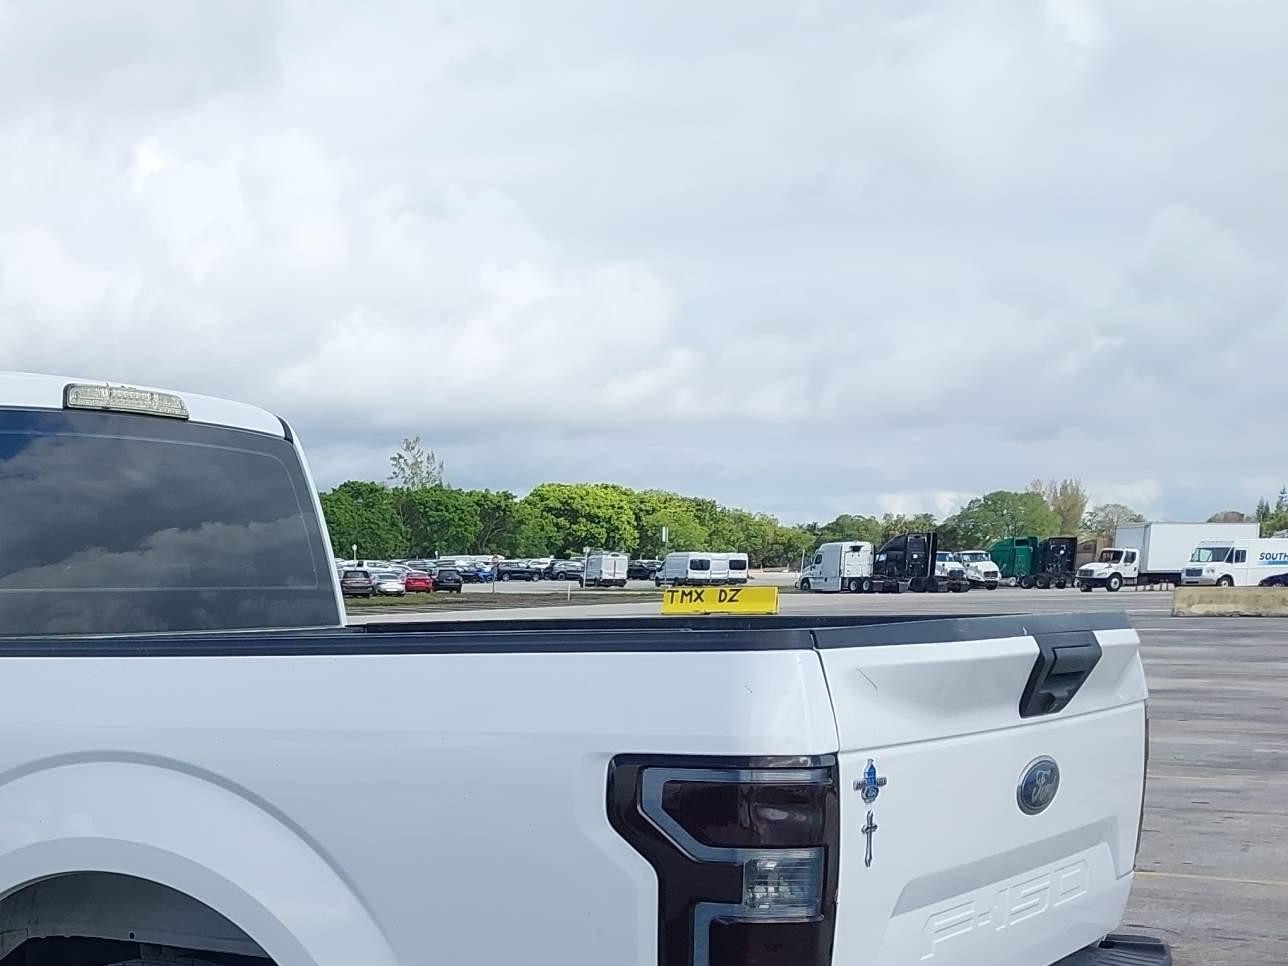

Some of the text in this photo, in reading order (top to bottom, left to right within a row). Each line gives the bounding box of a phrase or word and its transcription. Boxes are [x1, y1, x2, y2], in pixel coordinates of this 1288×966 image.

[1258, 552, 1288, 561] SOUTH
[666, 588, 743, 604] TMX DZ
[920, 859, 1089, 960] F-150
